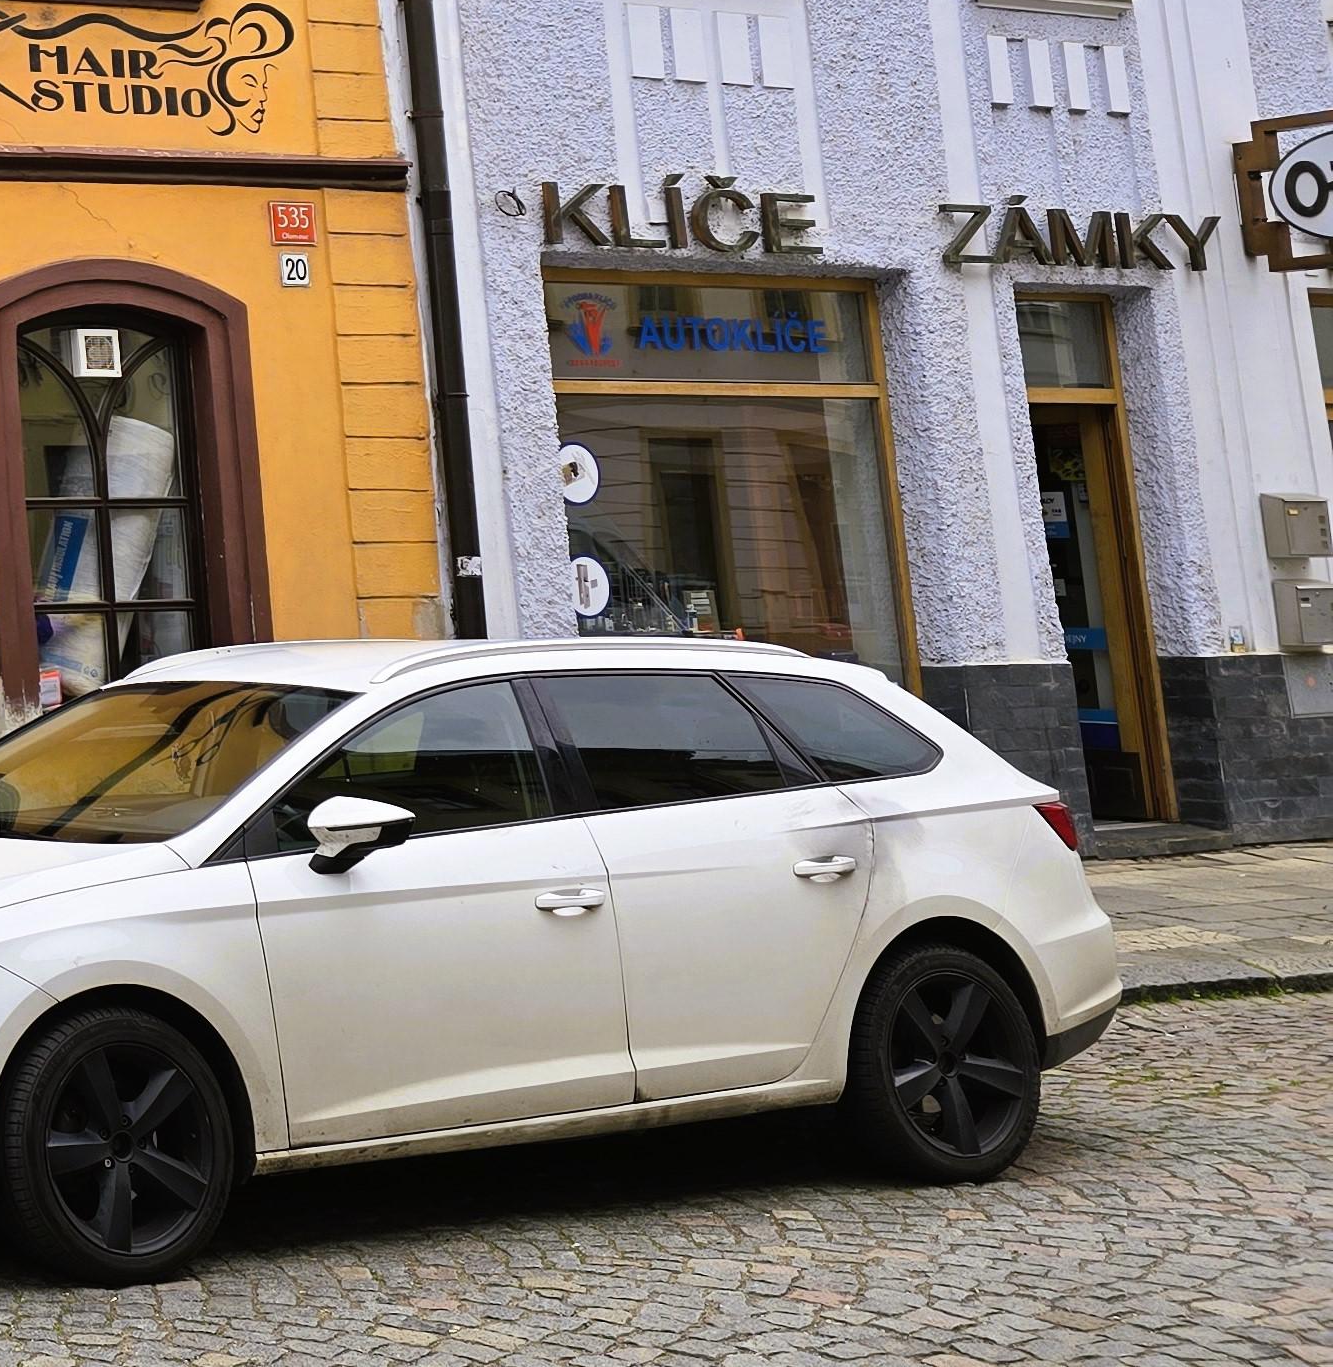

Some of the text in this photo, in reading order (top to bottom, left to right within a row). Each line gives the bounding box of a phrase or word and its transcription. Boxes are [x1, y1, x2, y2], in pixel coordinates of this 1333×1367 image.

[28, 43, 164, 80] HAIR
[31, 79, 213, 118] STUDIO
[277, 206, 310, 229] 535
[282, 232, 309, 240] Olomouc
[541, 173, 1221, 272] KLÍČE ZÁMKY
[285, 258, 307, 281] 20
[638, 311, 830, 354] AUTOKLÍČE
